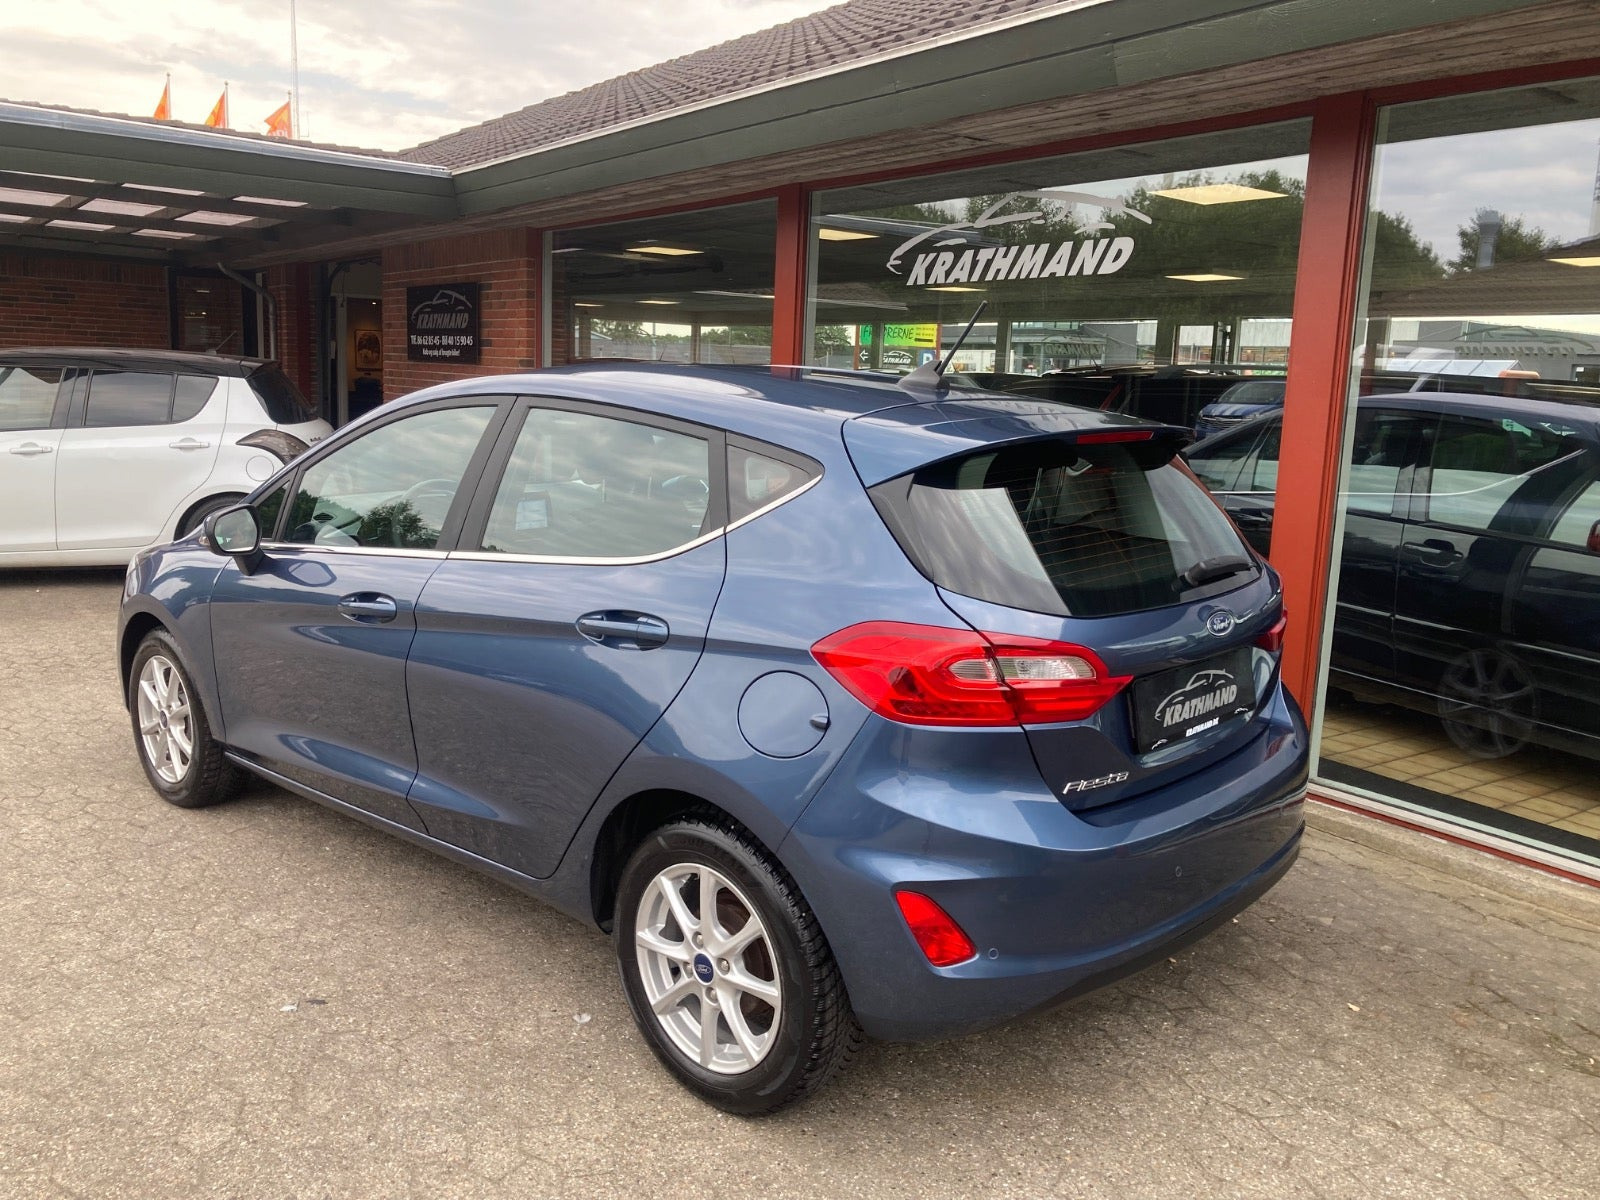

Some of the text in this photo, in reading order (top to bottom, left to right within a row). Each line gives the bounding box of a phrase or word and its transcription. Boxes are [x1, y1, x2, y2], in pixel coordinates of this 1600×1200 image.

[906, 236, 1135, 286] KRATHMAND
[417, 313, 469, 328] KRATHMAND
[1212, 616, 1231, 630] Ford
[1163, 684, 1238, 728] KRATHMAND
[1062, 771, 1129, 795] Fiesta
